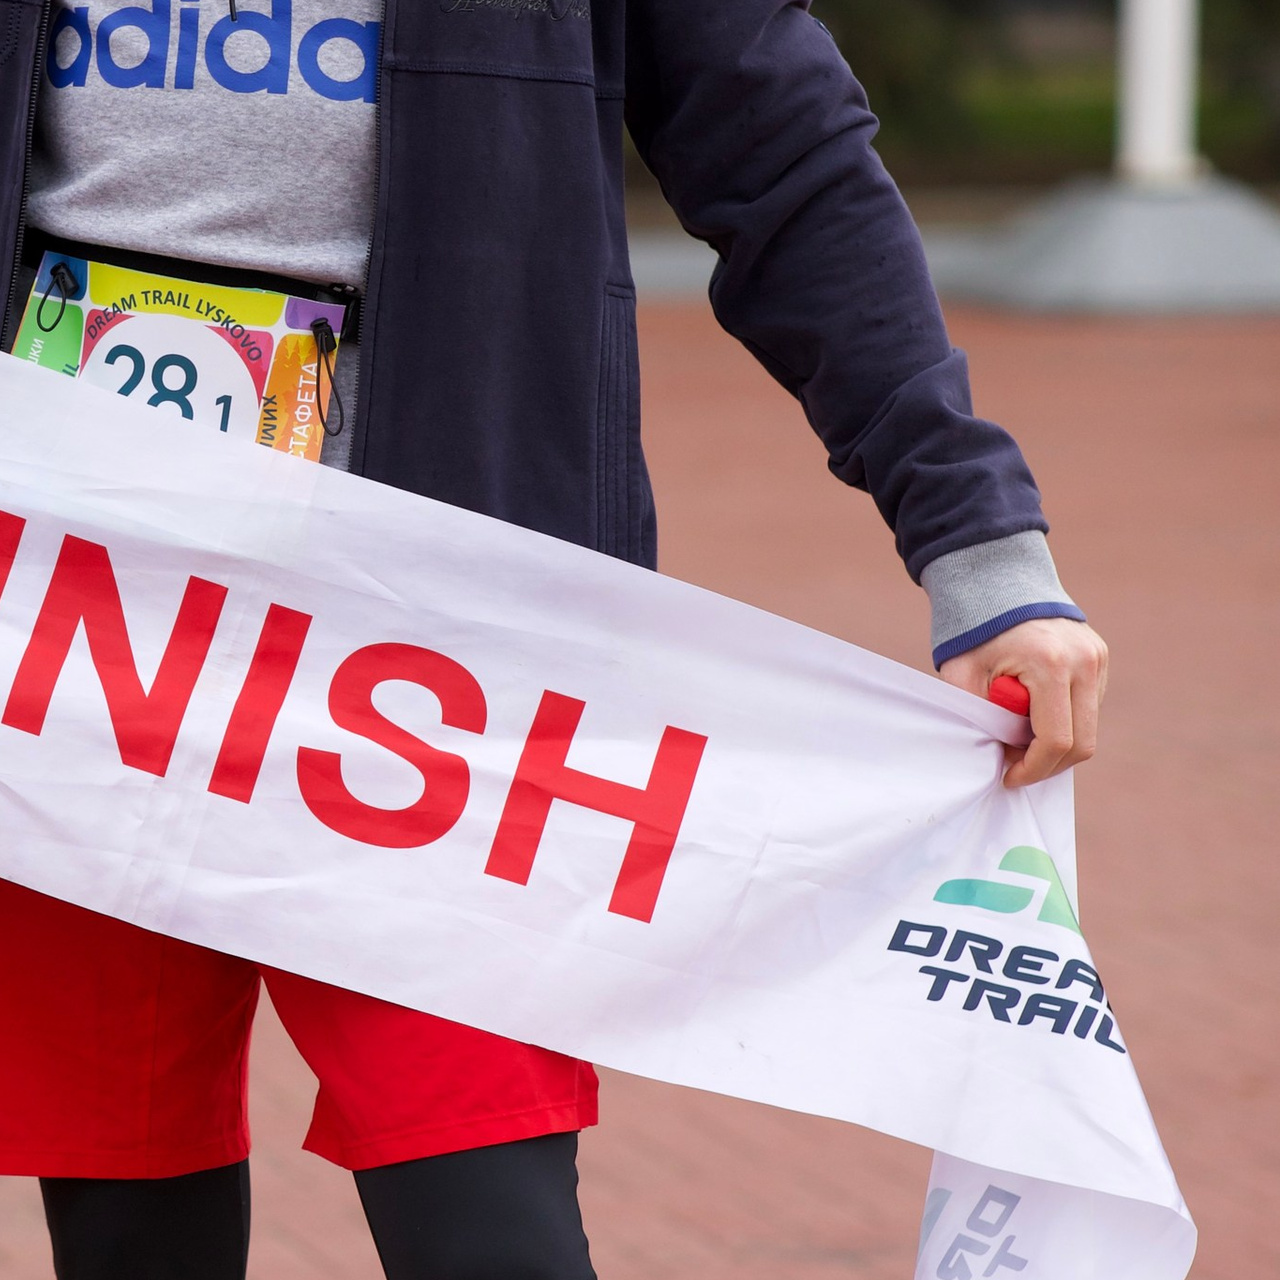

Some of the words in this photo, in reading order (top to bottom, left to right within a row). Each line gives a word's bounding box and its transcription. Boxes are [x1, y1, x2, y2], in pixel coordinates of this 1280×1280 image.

[87, 294, 137, 340] DREAM
[141, 289, 191, 310] TRAIL
[195, 298, 263, 362] LYSKOVO
[215, 394, 232, 433] 1
[887, 919, 1106, 1004] DREA
[918, 965, 1127, 1054] TRAIL
